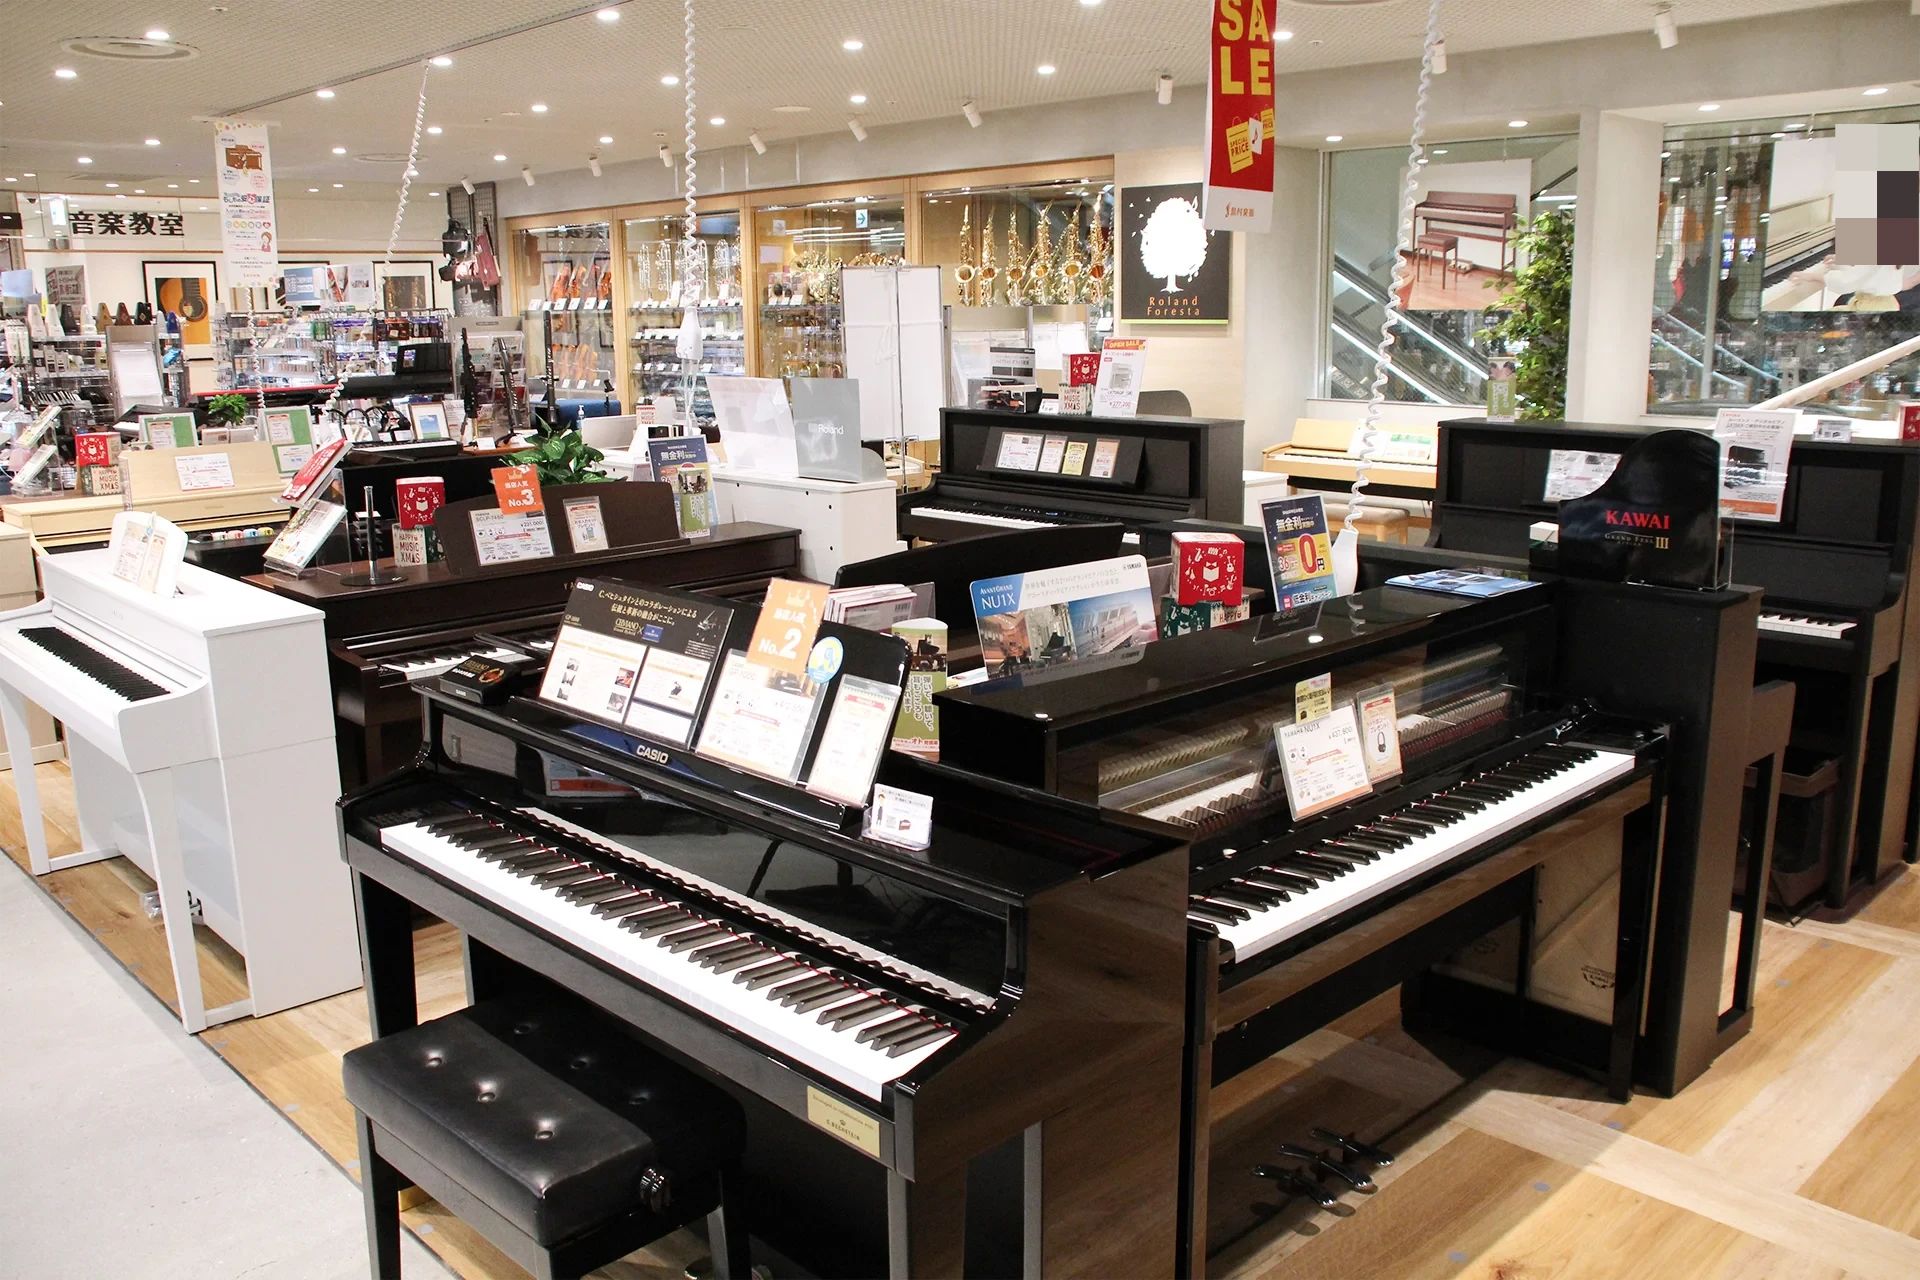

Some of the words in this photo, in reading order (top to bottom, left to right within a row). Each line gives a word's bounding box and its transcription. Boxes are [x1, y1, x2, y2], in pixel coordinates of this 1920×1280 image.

[1219, 0, 1269, 42] SA
[1220, 46, 1271, 96] LE
[1230, 137, 1248, 148] SPECIAL
[1231, 142, 1249, 157] PRICE
[68, 210, 185, 237] 音楽教室
[1149, 296, 1198, 306] Roland
[1147, 306, 1200, 316] Foresta
[817, 423, 844, 436] Roland
[99, 475, 119, 483] MUSIC
[508, 488, 535, 507] No.3
[1276, 515, 1302, 533] 無金利
[1605, 509, 1670, 530] KAWAI
[400, 542, 419, 552] MUSIC
[1655, 536, 1669, 550] III
[981, 592, 1016, 610] NU1X
[758, 628, 802, 660] No.2
[637, 744, 668, 763] CASIO
